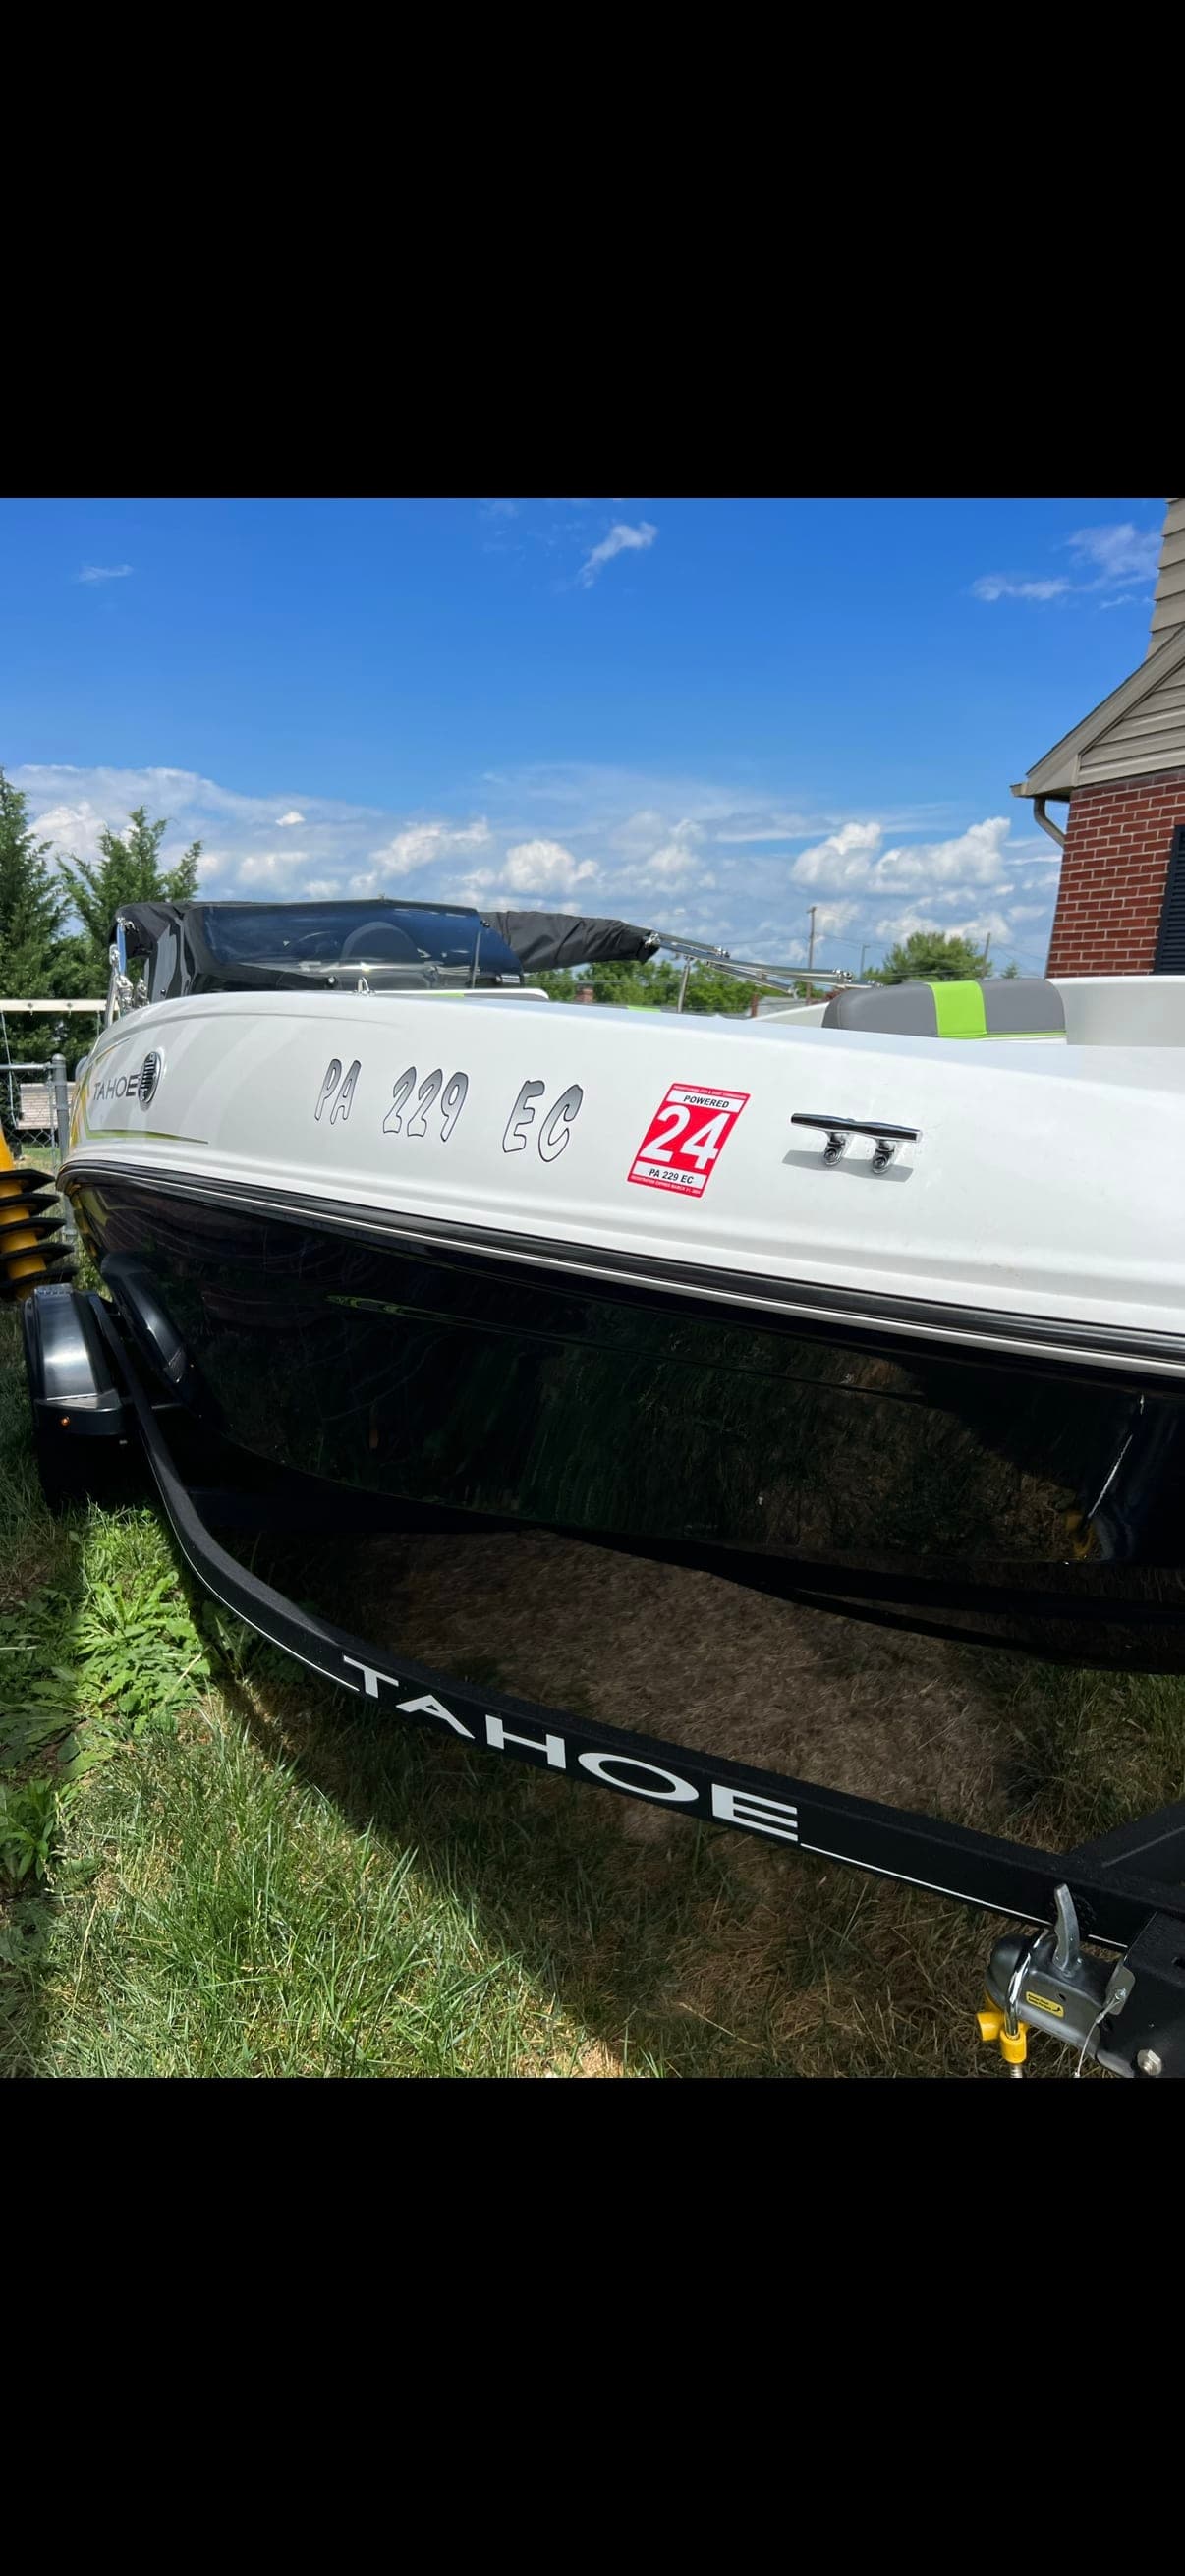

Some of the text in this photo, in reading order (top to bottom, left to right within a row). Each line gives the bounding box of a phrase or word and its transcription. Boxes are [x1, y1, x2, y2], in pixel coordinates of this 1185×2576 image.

[93, 1074, 141, 1100] TAHOE
[314, 1058, 584, 1162] PA 229 EC
[683, 1094, 730, 1109] POWERED
[638, 1104, 731, 1170] 24
[649, 1168, 660, 1178] PA
[662, 1171, 679, 1181] 229
[680, 1174, 694, 1185] EC
[344, 1655, 799, 1842] TAHOE
